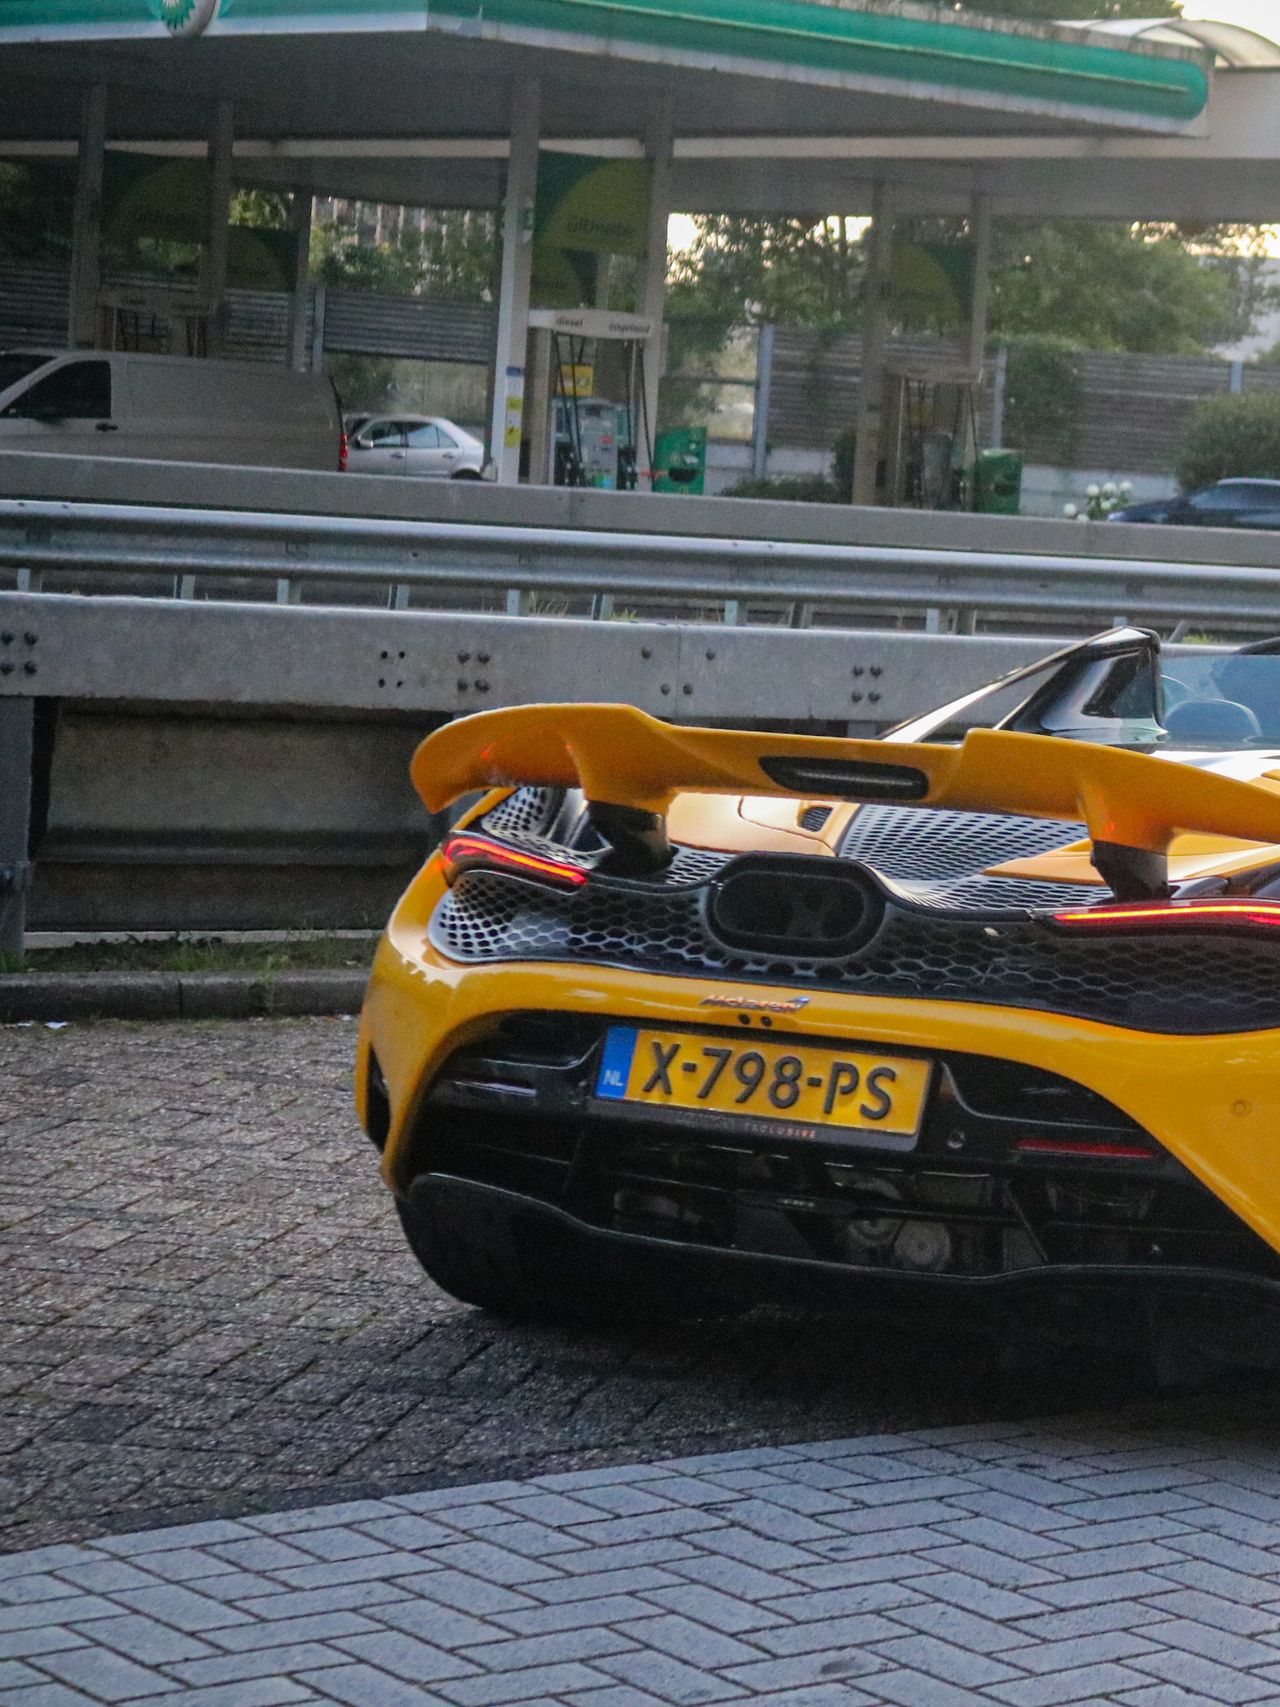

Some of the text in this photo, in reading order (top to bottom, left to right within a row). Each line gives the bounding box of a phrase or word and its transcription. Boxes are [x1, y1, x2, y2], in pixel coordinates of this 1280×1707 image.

[555, 317, 583, 328] diesel
[603, 1069, 624, 1087] NL
[641, 1040, 897, 1121] X-798-PS
